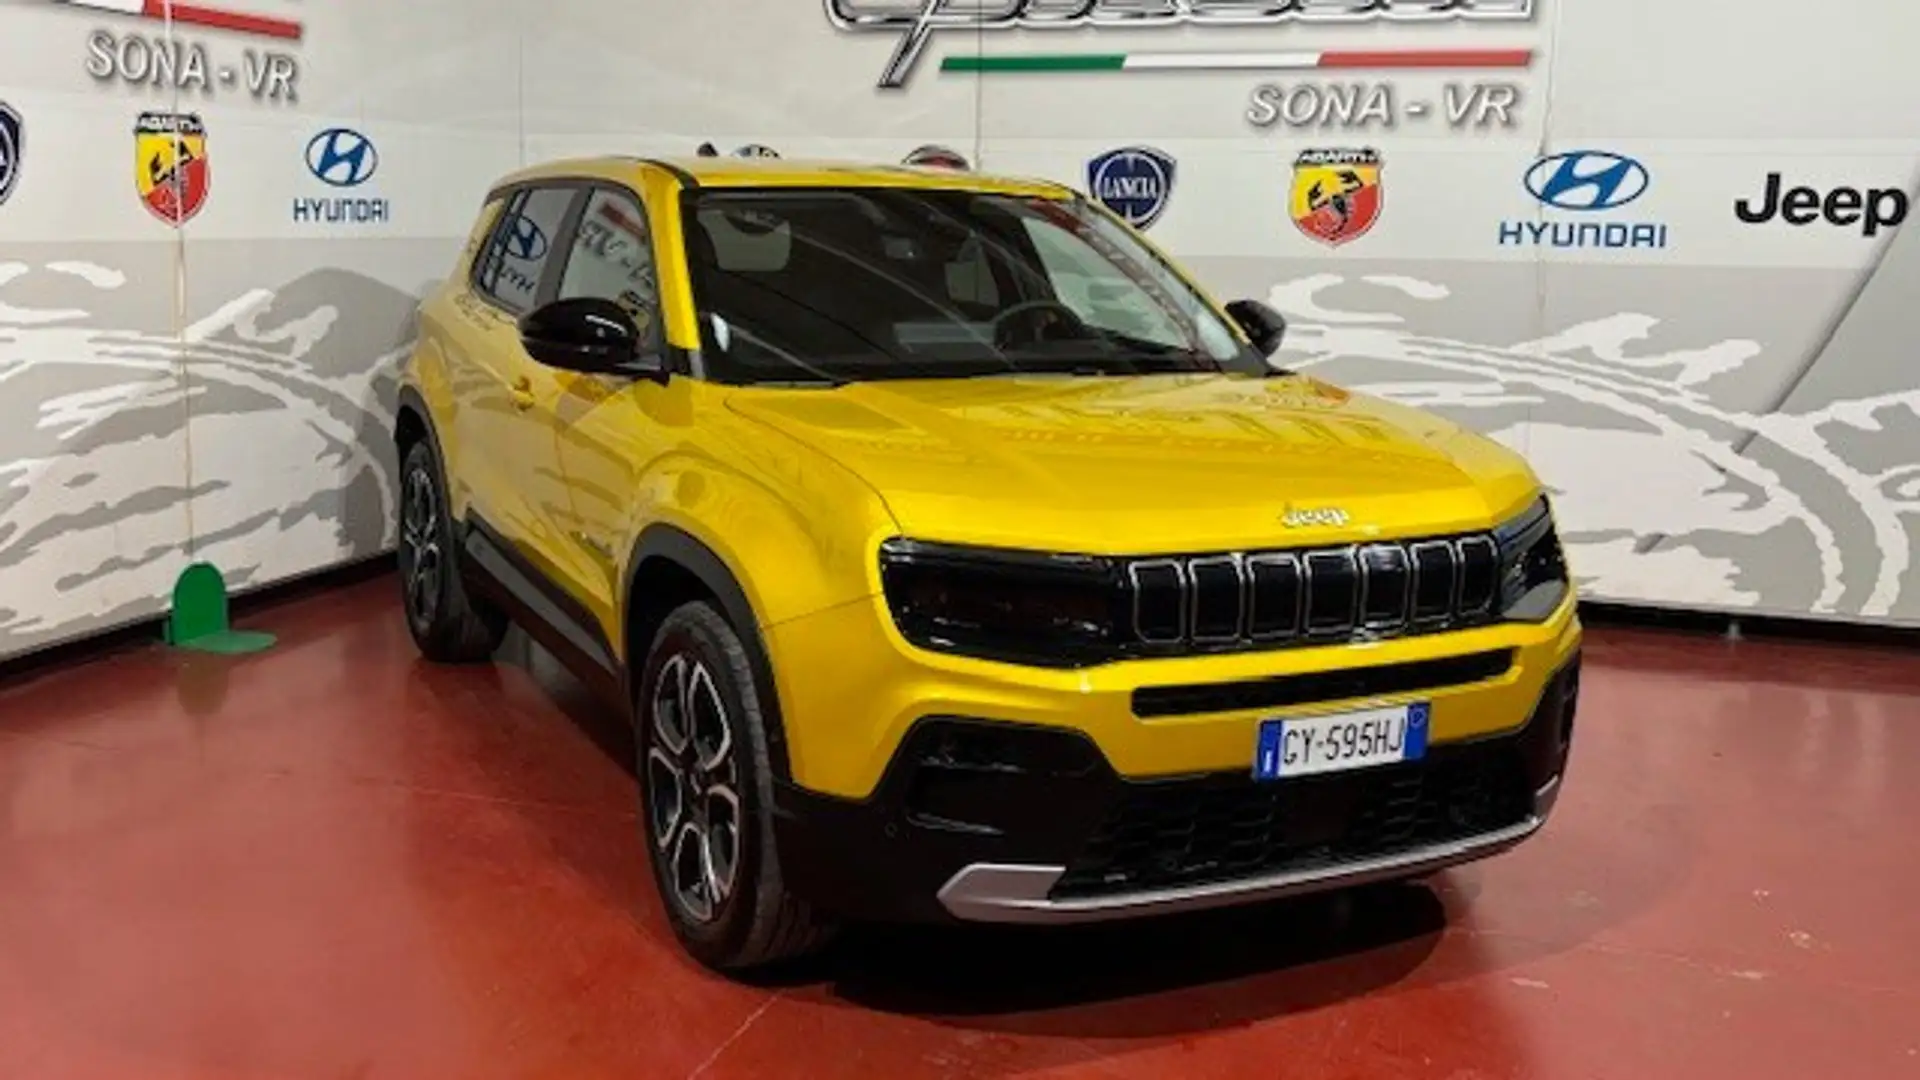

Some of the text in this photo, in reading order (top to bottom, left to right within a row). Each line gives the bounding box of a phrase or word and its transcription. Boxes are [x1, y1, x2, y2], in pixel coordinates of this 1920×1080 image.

[87, 30, 210, 90] SONA
[243, 49, 298, 99] VR
[1248, 84, 1393, 126] SONA
[1445, 84, 1517, 126] VR
[1103, 176, 1157, 198] LANCIA
[293, 198, 388, 222] HYUNDAI
[1734, 172, 1909, 237] Jeep
[1498, 221, 1667, 247] HYUNDAI
[1280, 503, 1350, 527] Jeep
